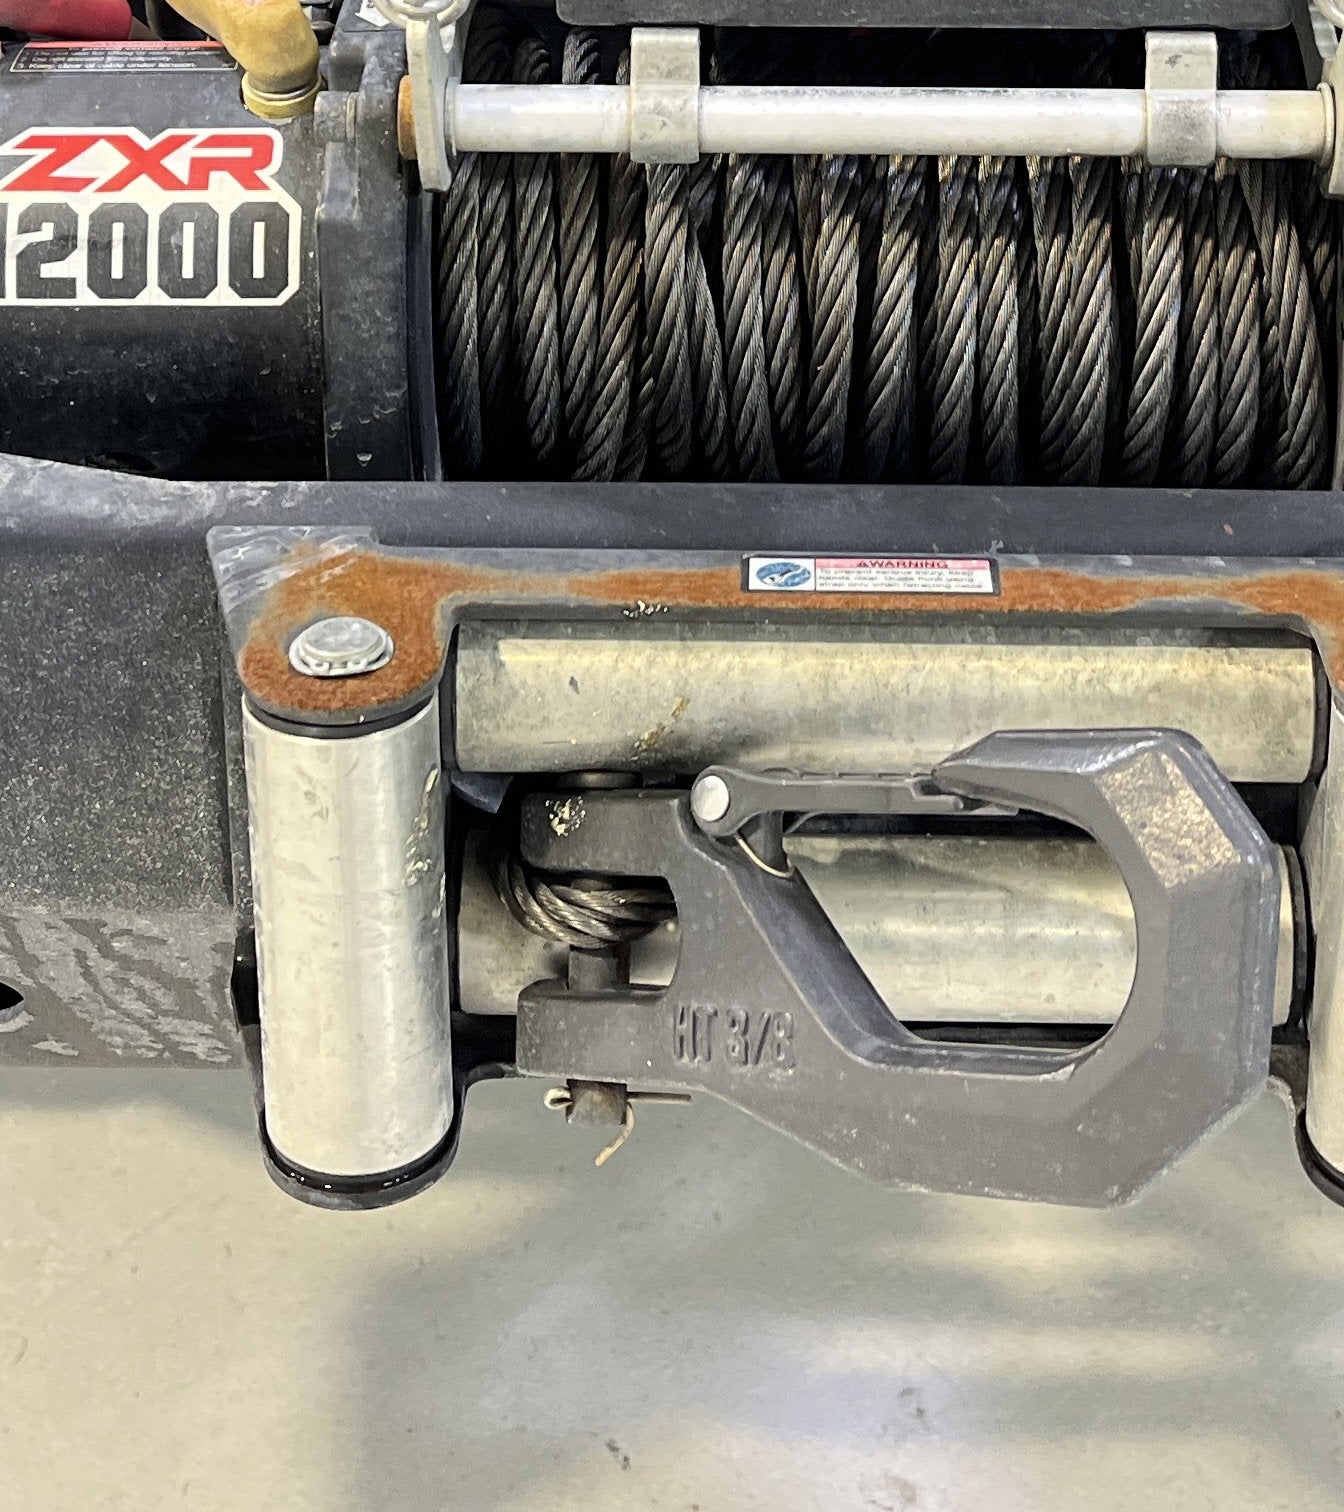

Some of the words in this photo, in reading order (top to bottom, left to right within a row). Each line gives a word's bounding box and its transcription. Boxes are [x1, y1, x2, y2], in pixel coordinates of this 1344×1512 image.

[0, 134, 276, 193] ZXR
[869, 560, 949, 569] WARNING
[673, 1003, 719, 1064] HT
